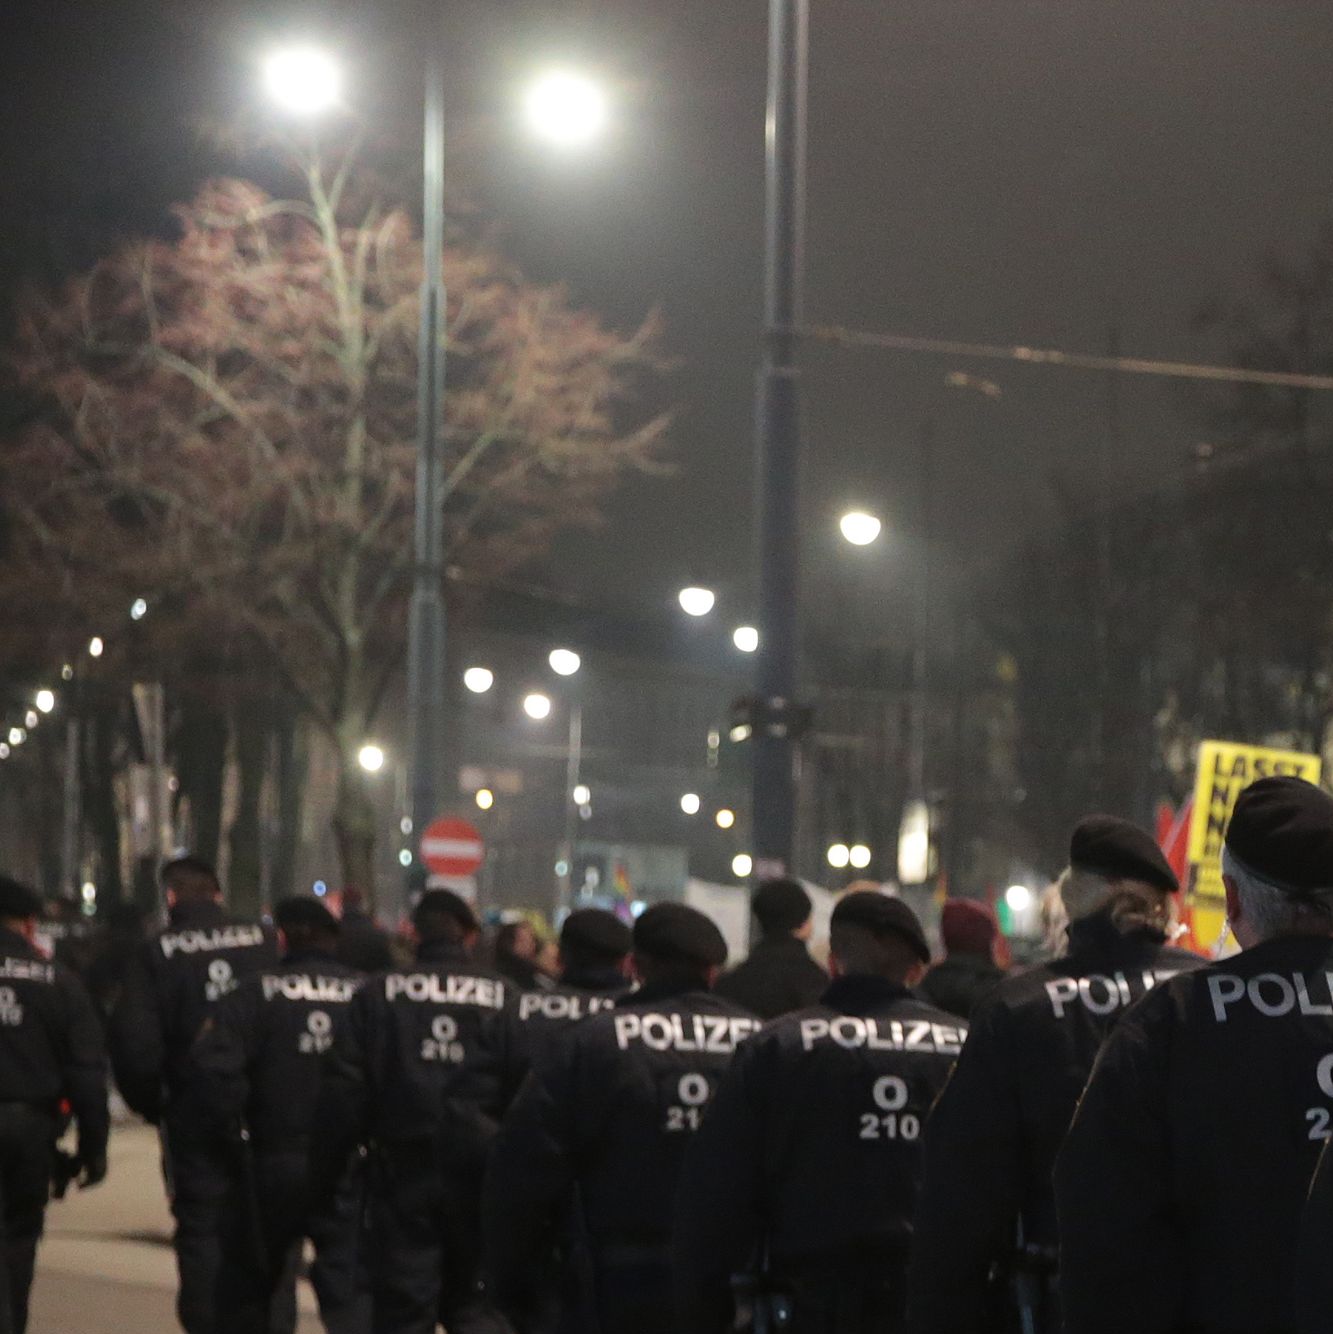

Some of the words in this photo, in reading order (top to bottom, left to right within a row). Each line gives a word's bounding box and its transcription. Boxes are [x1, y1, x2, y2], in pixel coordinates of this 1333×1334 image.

[208, 959, 233, 984] O
[385, 973, 505, 1010] POLIZEI
[307, 1010, 332, 1037] O
[431, 1014, 458, 1042] O
[677, 1072, 709, 1106] O
[873, 1075, 909, 1111] O
[859, 1113, 920, 1140] 210
